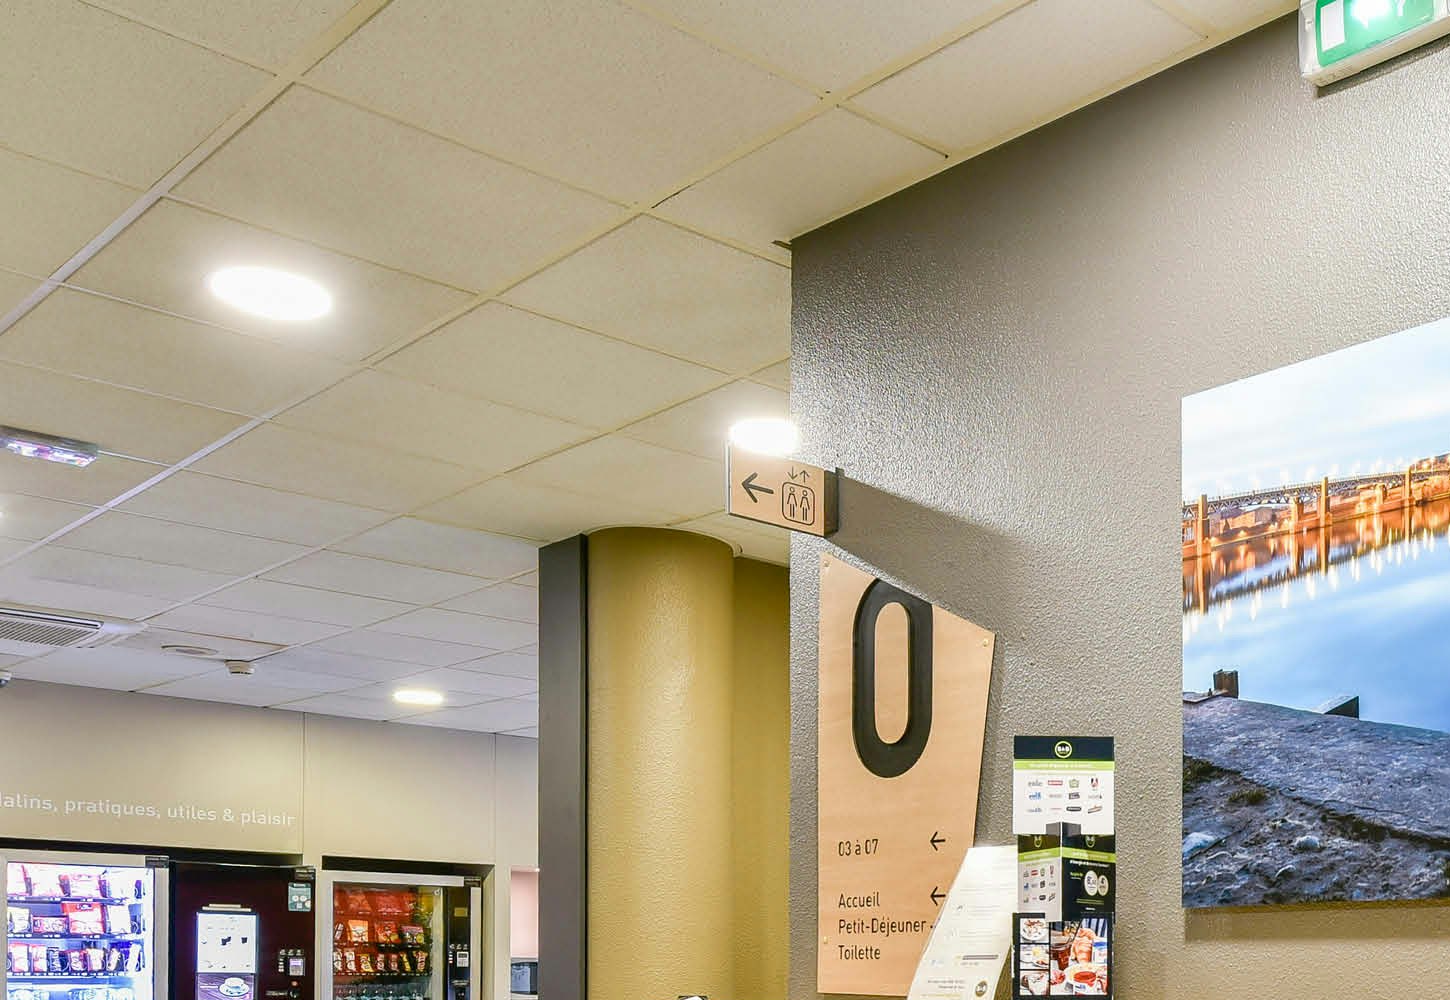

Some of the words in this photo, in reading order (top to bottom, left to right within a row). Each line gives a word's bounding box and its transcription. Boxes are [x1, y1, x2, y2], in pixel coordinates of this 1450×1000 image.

[65, 799, 161, 820] pratiques,
[167, 806, 217, 821] utiles
[222, 808, 234, 822] &
[241, 811, 295, 826] plaisir
[838, 840, 852, 857] 03
[855, 840, 861, 856] à
[864, 838, 879, 855] 07
[838, 891, 880, 908] Accueil
[838, 916, 927, 937] Petit-Déjeuner
[838, 944, 881, 961] Toilette
